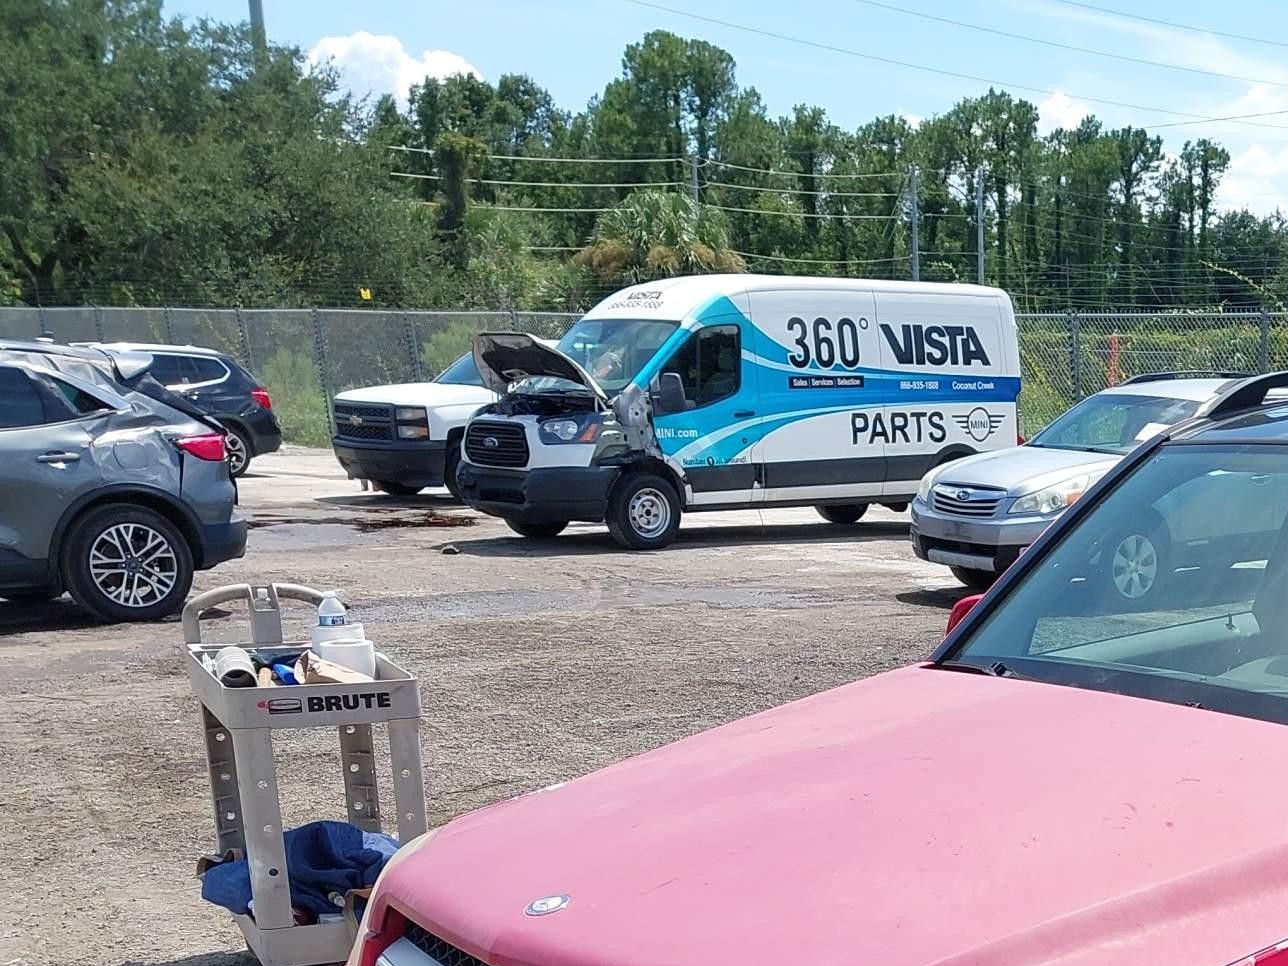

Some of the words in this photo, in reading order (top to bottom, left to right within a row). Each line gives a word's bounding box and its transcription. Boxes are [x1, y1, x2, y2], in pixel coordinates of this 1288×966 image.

[878, 323, 992, 367] VISTA
[792, 378, 809, 387] Sales
[811, 377, 834, 387] Services
[837, 377, 861, 386] Selection
[952, 381, 978, 391] Coconut
[977, 381, 995, 391] Creek
[850, 411, 947, 445] PARTS
[970, 421, 988, 430] MINI
[307, 692, 392, 712] BRUTE
